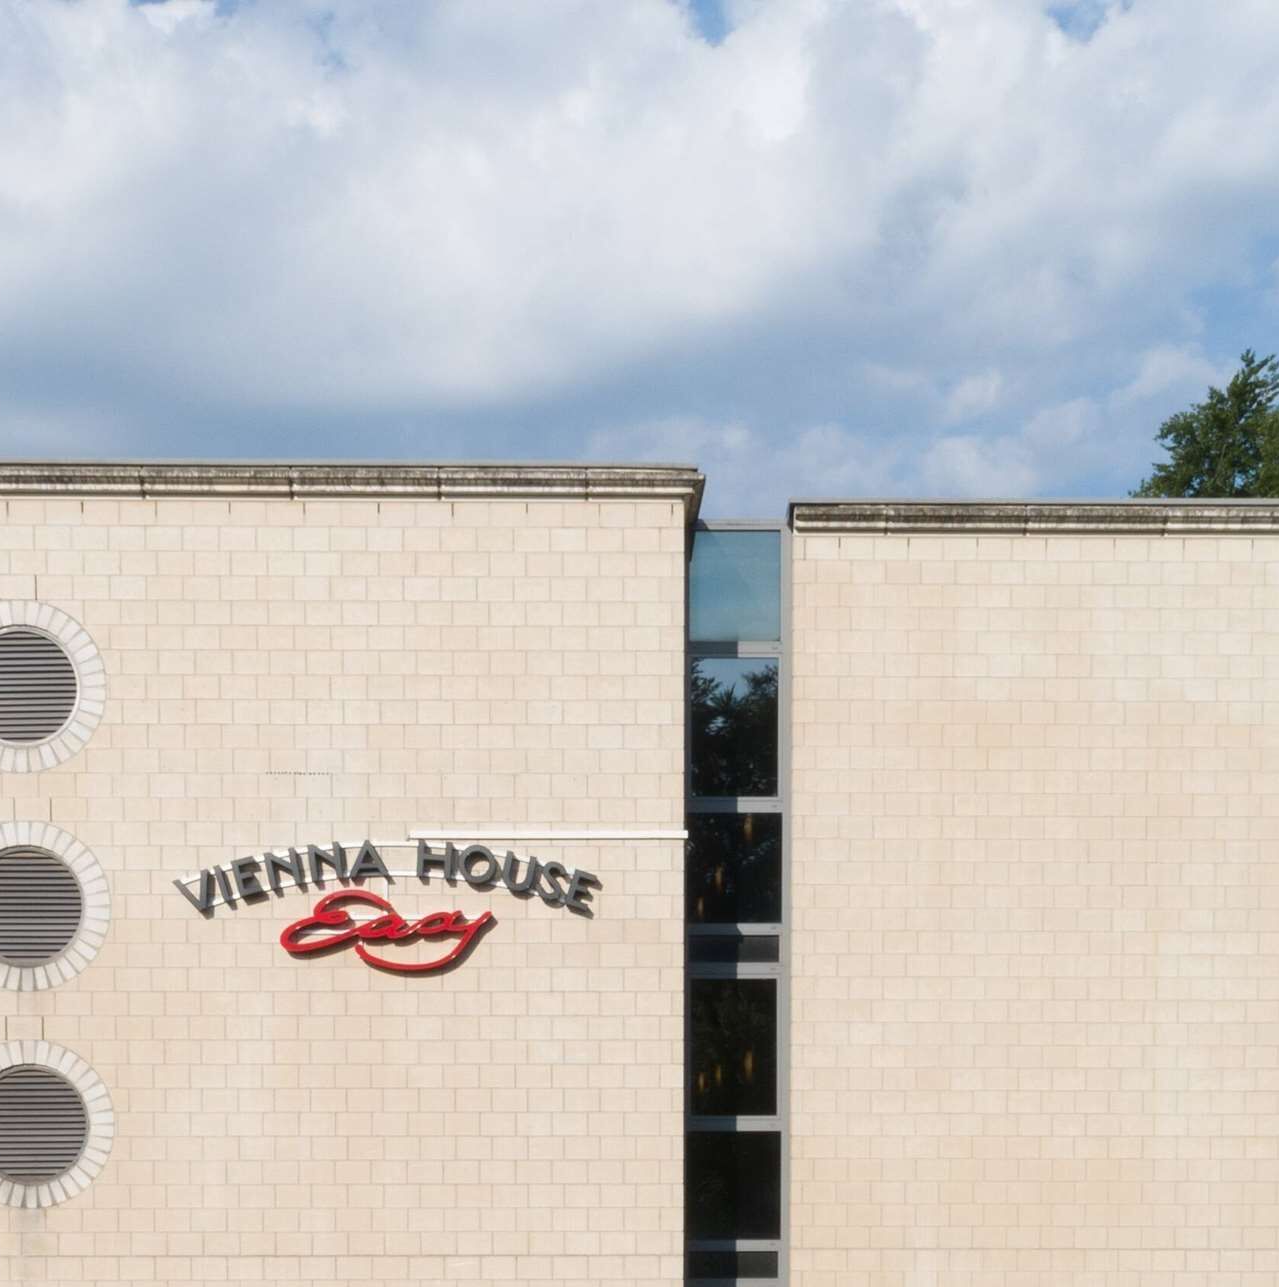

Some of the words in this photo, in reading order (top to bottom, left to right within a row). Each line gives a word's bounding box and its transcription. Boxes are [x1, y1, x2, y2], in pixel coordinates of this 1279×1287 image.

[173, 840, 392, 914] VIENNA
[417, 840, 600, 915] HOUSE
[280, 889, 494, 973] Easy
